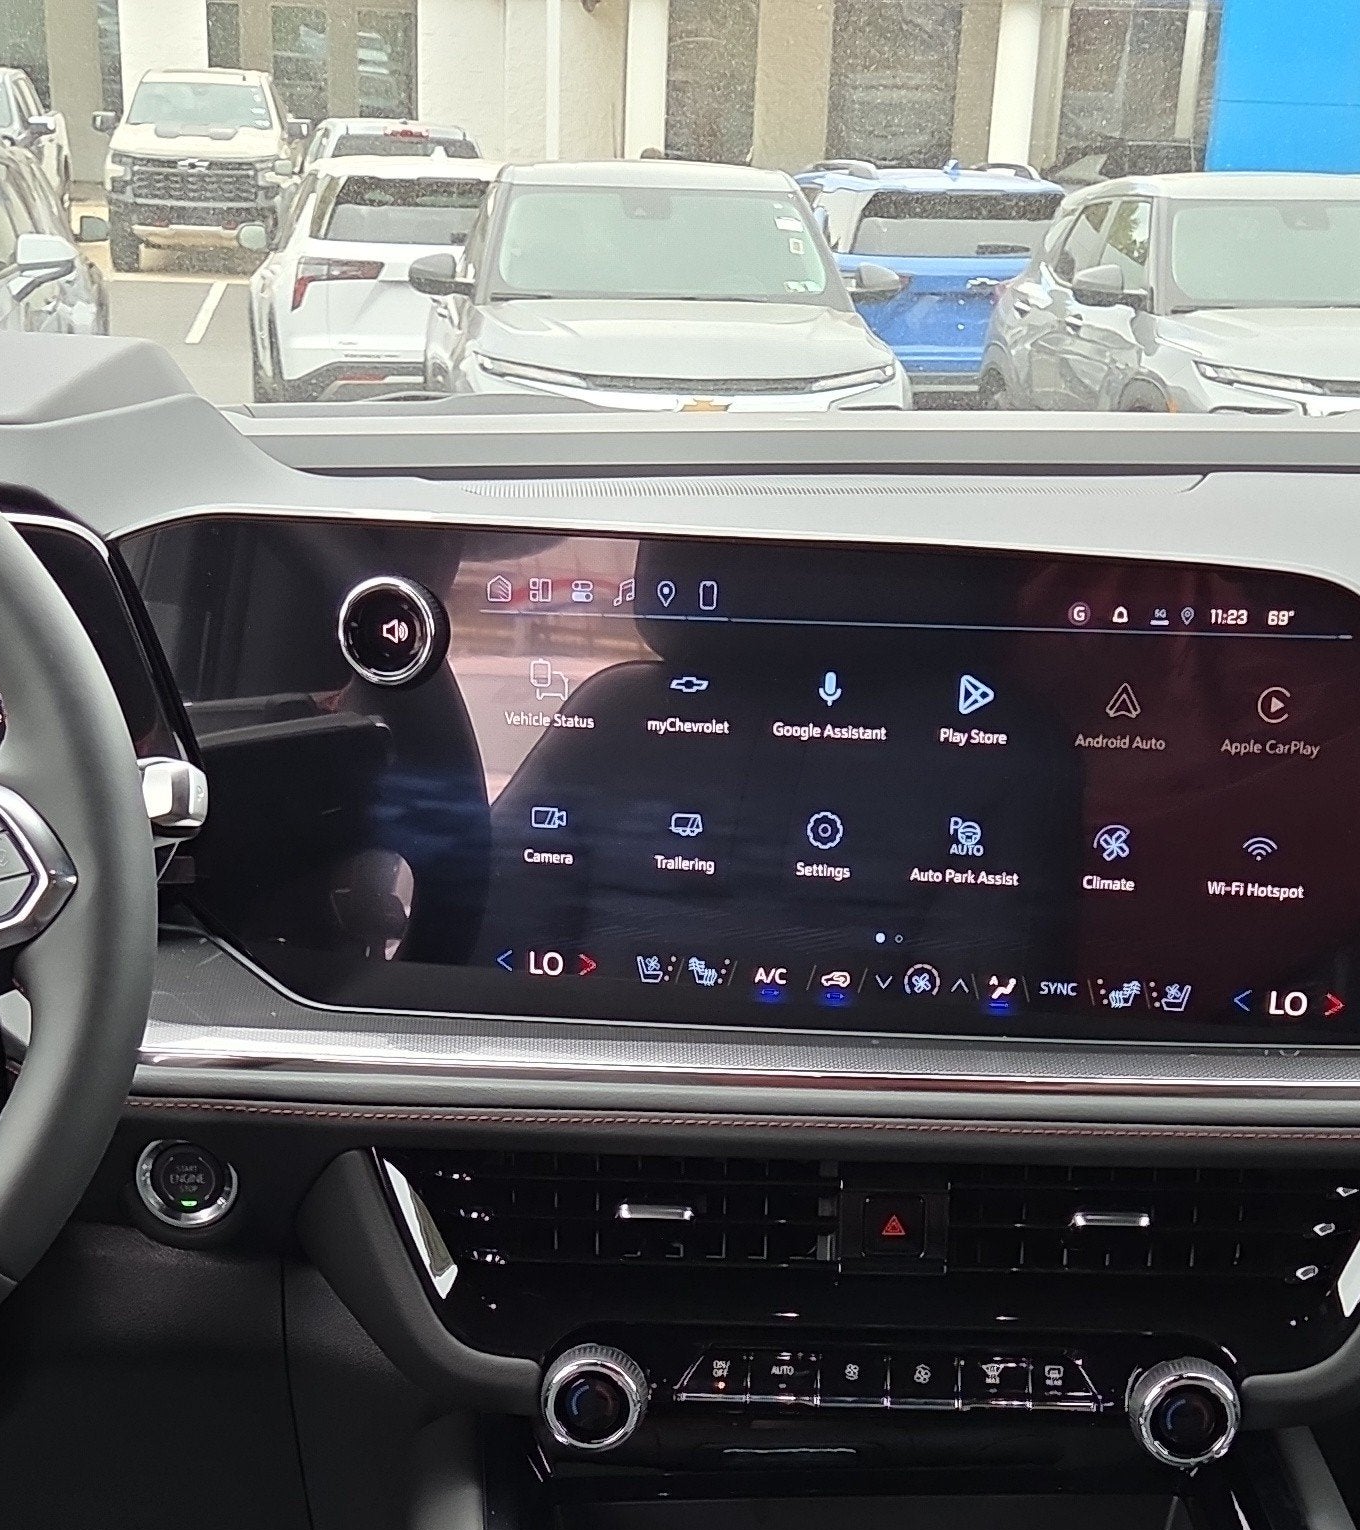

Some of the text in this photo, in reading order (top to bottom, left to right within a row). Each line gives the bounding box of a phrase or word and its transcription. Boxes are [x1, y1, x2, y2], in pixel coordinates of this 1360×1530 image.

[1210, 608, 1248, 626] 11:23
[505, 711, 595, 730] Vehicle Status
[647, 717, 730, 736] myChevrolet
[772, 722, 887, 741] Google Assistant
[939, 727, 1008, 746] Play Store
[1074, 732, 1166, 751] Android Auto
[1221, 739, 1321, 760] Apple CarPlay
[523, 848, 574, 866] Camera
[949, 843, 985, 857] AUTO
[654, 854, 716, 875] Trailering
[795, 861, 851, 882] Settings
[910, 867, 1019, 887] Auto Park Assist
[1082, 875, 1136, 892] Climate
[1207, 880, 1305, 901] Wi-Fi Hotspot
[528, 950, 565, 977] LO
[754, 966, 788, 986] A/C
[1039, 981, 1079, 998] SYNC
[1269, 990, 1308, 1017] LO
[770, 1365, 795, 1376] AUTO
